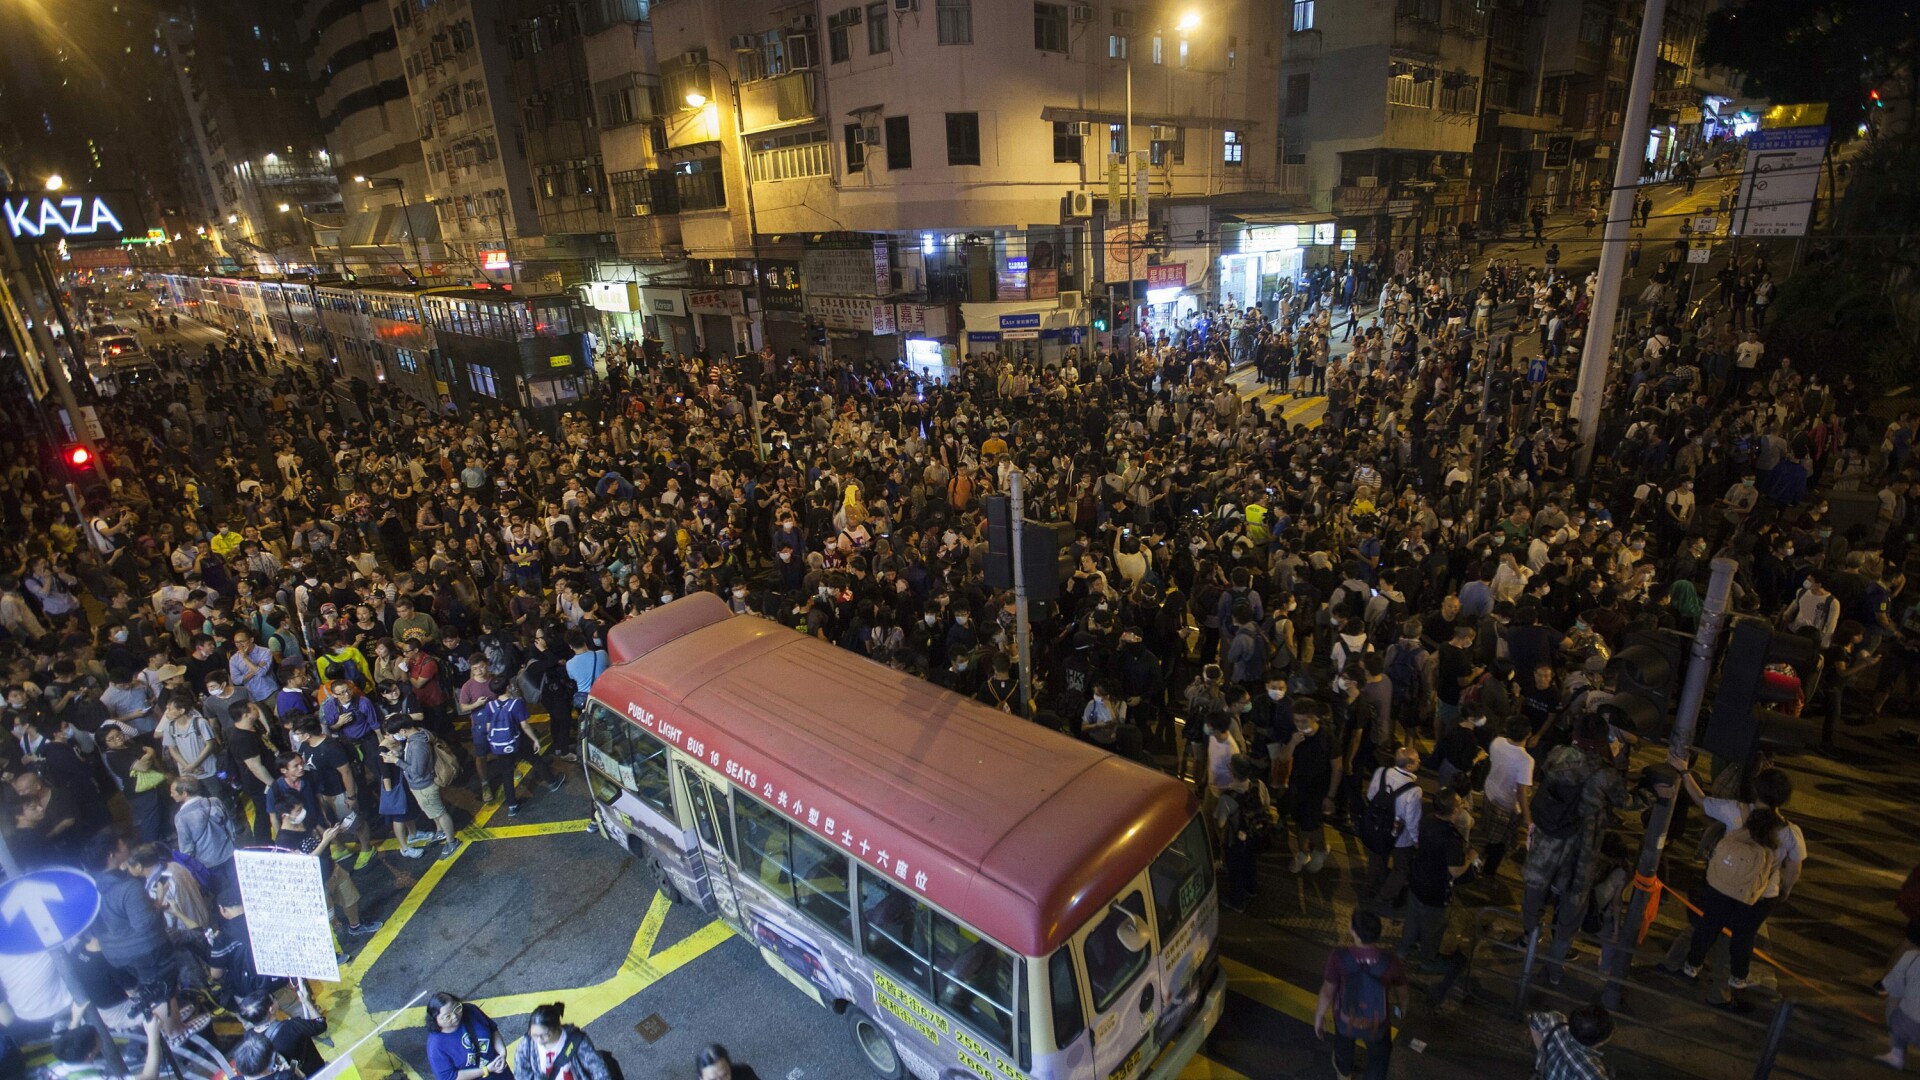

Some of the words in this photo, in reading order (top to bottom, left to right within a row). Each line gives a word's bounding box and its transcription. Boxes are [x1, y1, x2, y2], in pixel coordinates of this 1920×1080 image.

[3, 196, 123, 238] KAZA
[531, 283, 552, 292] 78
[1149, 267, 1183, 283] 星輝電訊
[655, 300, 673, 310] Korean
[628, 702, 654, 727] PUBLIC
[658, 719, 683, 743] LIGHT
[686, 735, 705, 757] BUS
[710, 751, 719, 766] 16
[725, 759, 757, 788] SEATS
[764, 782, 928, 892] 公共小型巴士十六座位
[956, 1030, 991, 1063] 2554
[996, 1058, 1030, 1080] 255
